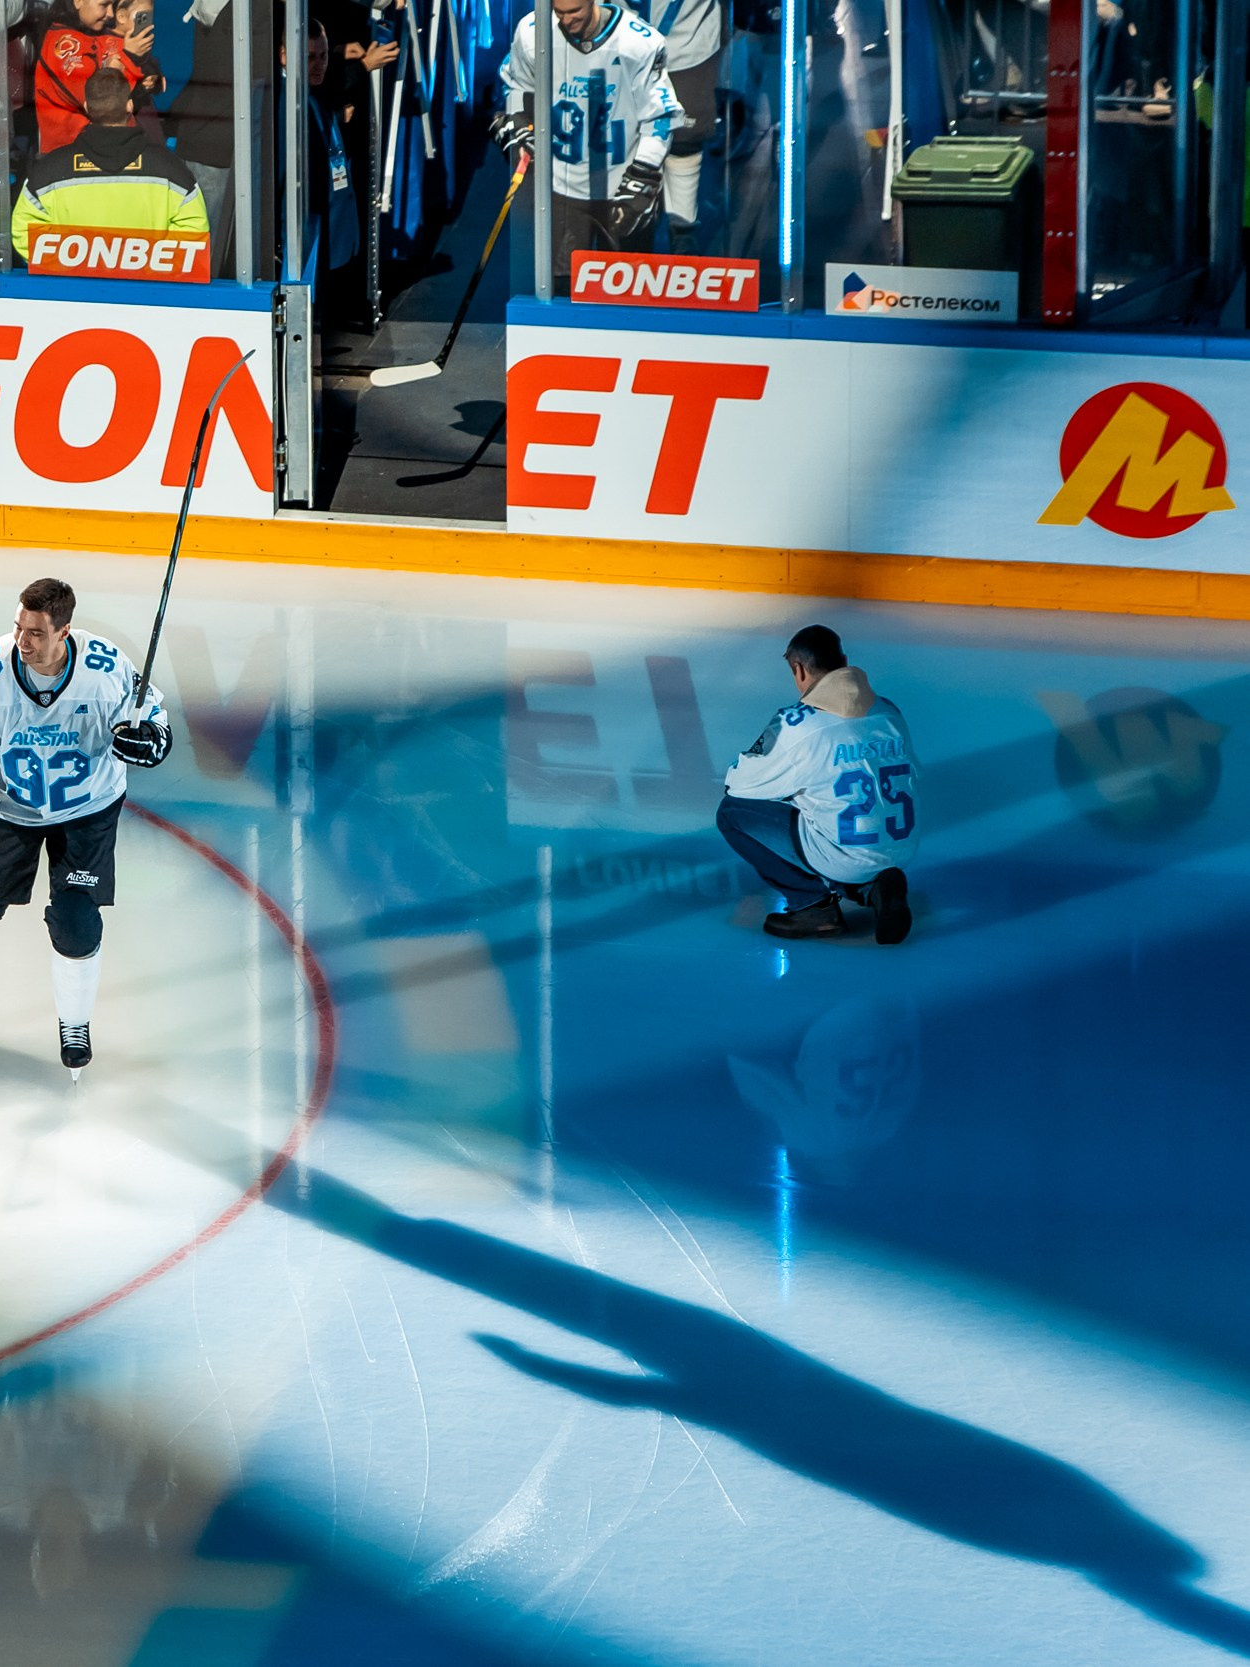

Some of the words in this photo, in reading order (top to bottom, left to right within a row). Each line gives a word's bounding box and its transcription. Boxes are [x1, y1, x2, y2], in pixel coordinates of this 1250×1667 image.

[32, 232, 206, 274] FONBET
[573, 260, 757, 303] FONBET
[871, 289, 1001, 313] Ростелеком
[84, 638, 119, 674] 92
[1, 747, 93, 813] 92
[833, 763, 916, 846] 25
